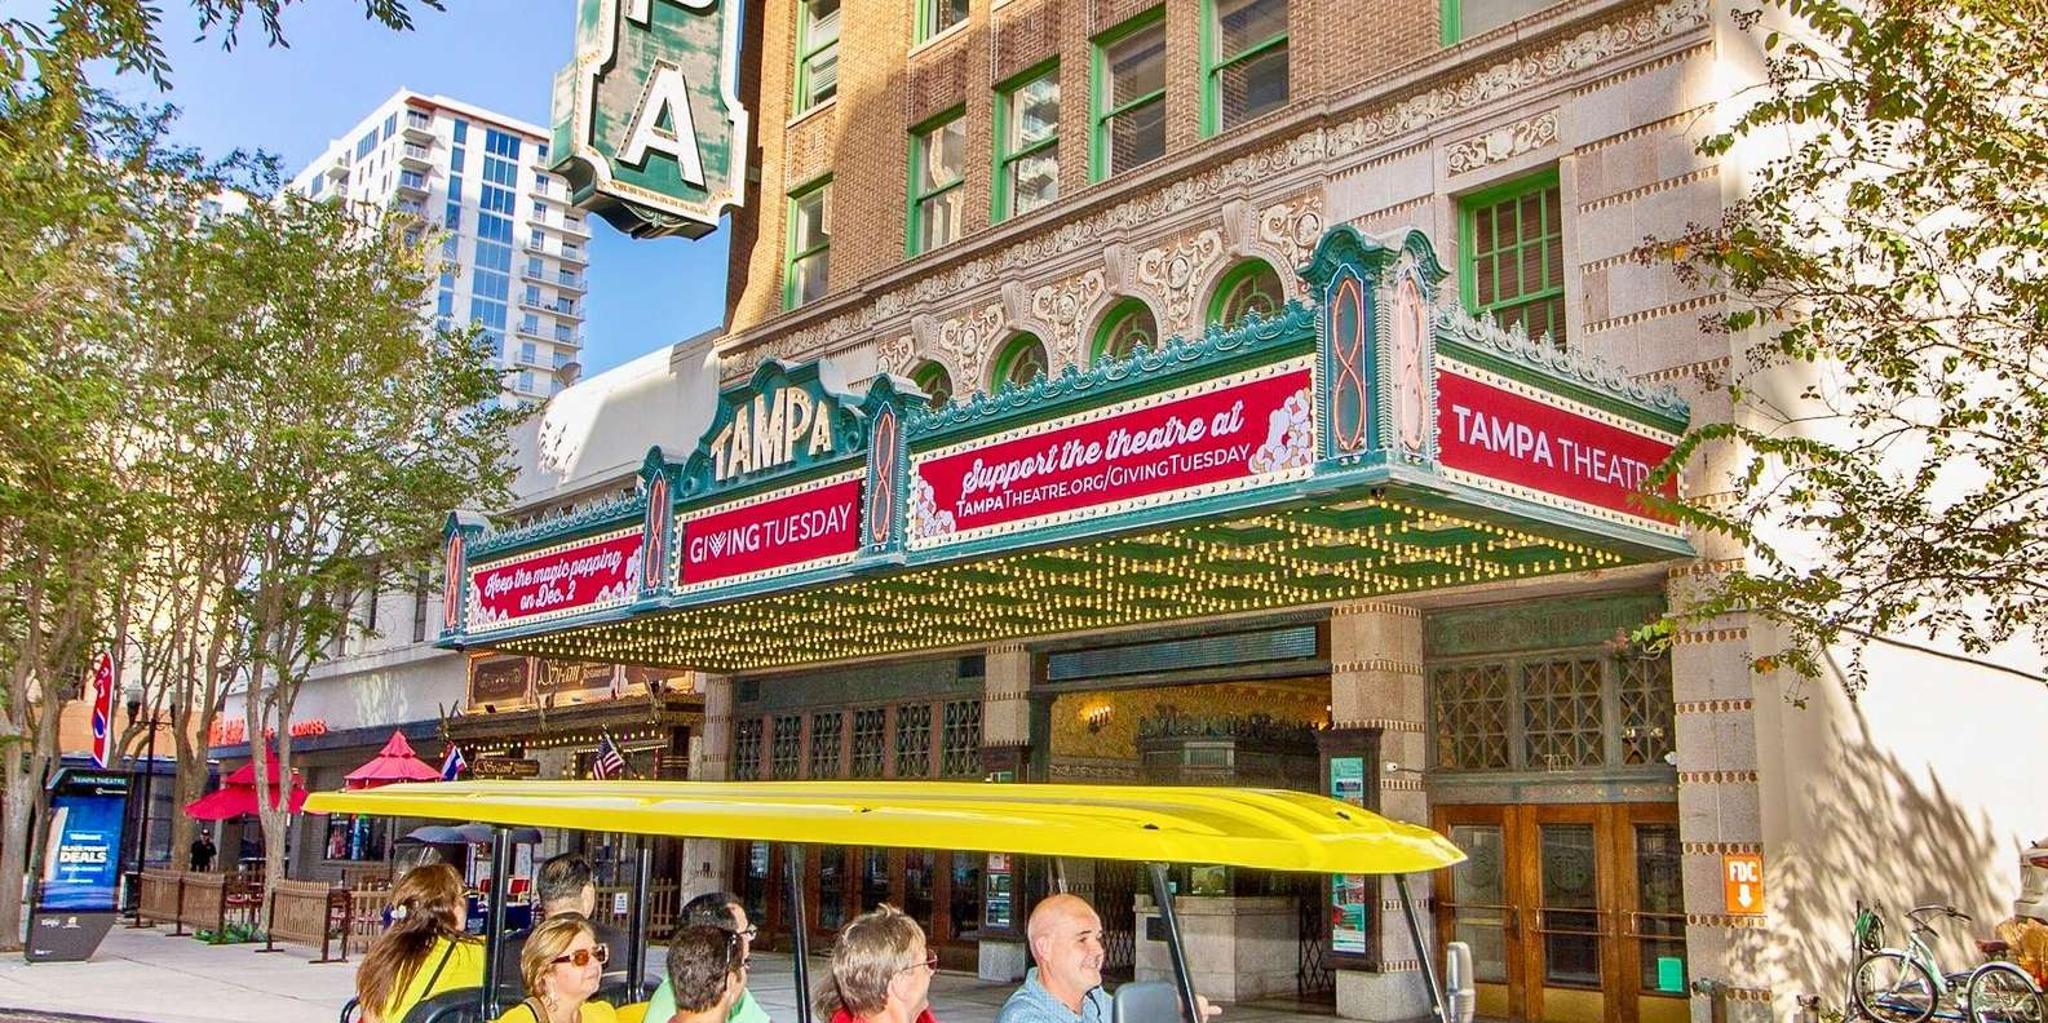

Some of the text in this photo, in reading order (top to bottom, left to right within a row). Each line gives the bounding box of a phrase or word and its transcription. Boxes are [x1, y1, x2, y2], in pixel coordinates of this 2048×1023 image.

[710, 386, 831, 481] TAMPA
[962, 399, 1244, 496] Support the theatre at
[1452, 403, 1656, 496] TAMPA THEATR
[689, 502, 853, 564] GIVING TUESDAY
[485, 548, 622, 599] Keep the magic popping
[520, 580, 577, 610] on Dec. 2
[96, 776, 127, 786] THEATRE
[60, 851, 107, 863] DEALS
[1728, 861, 1758, 883] FDC
